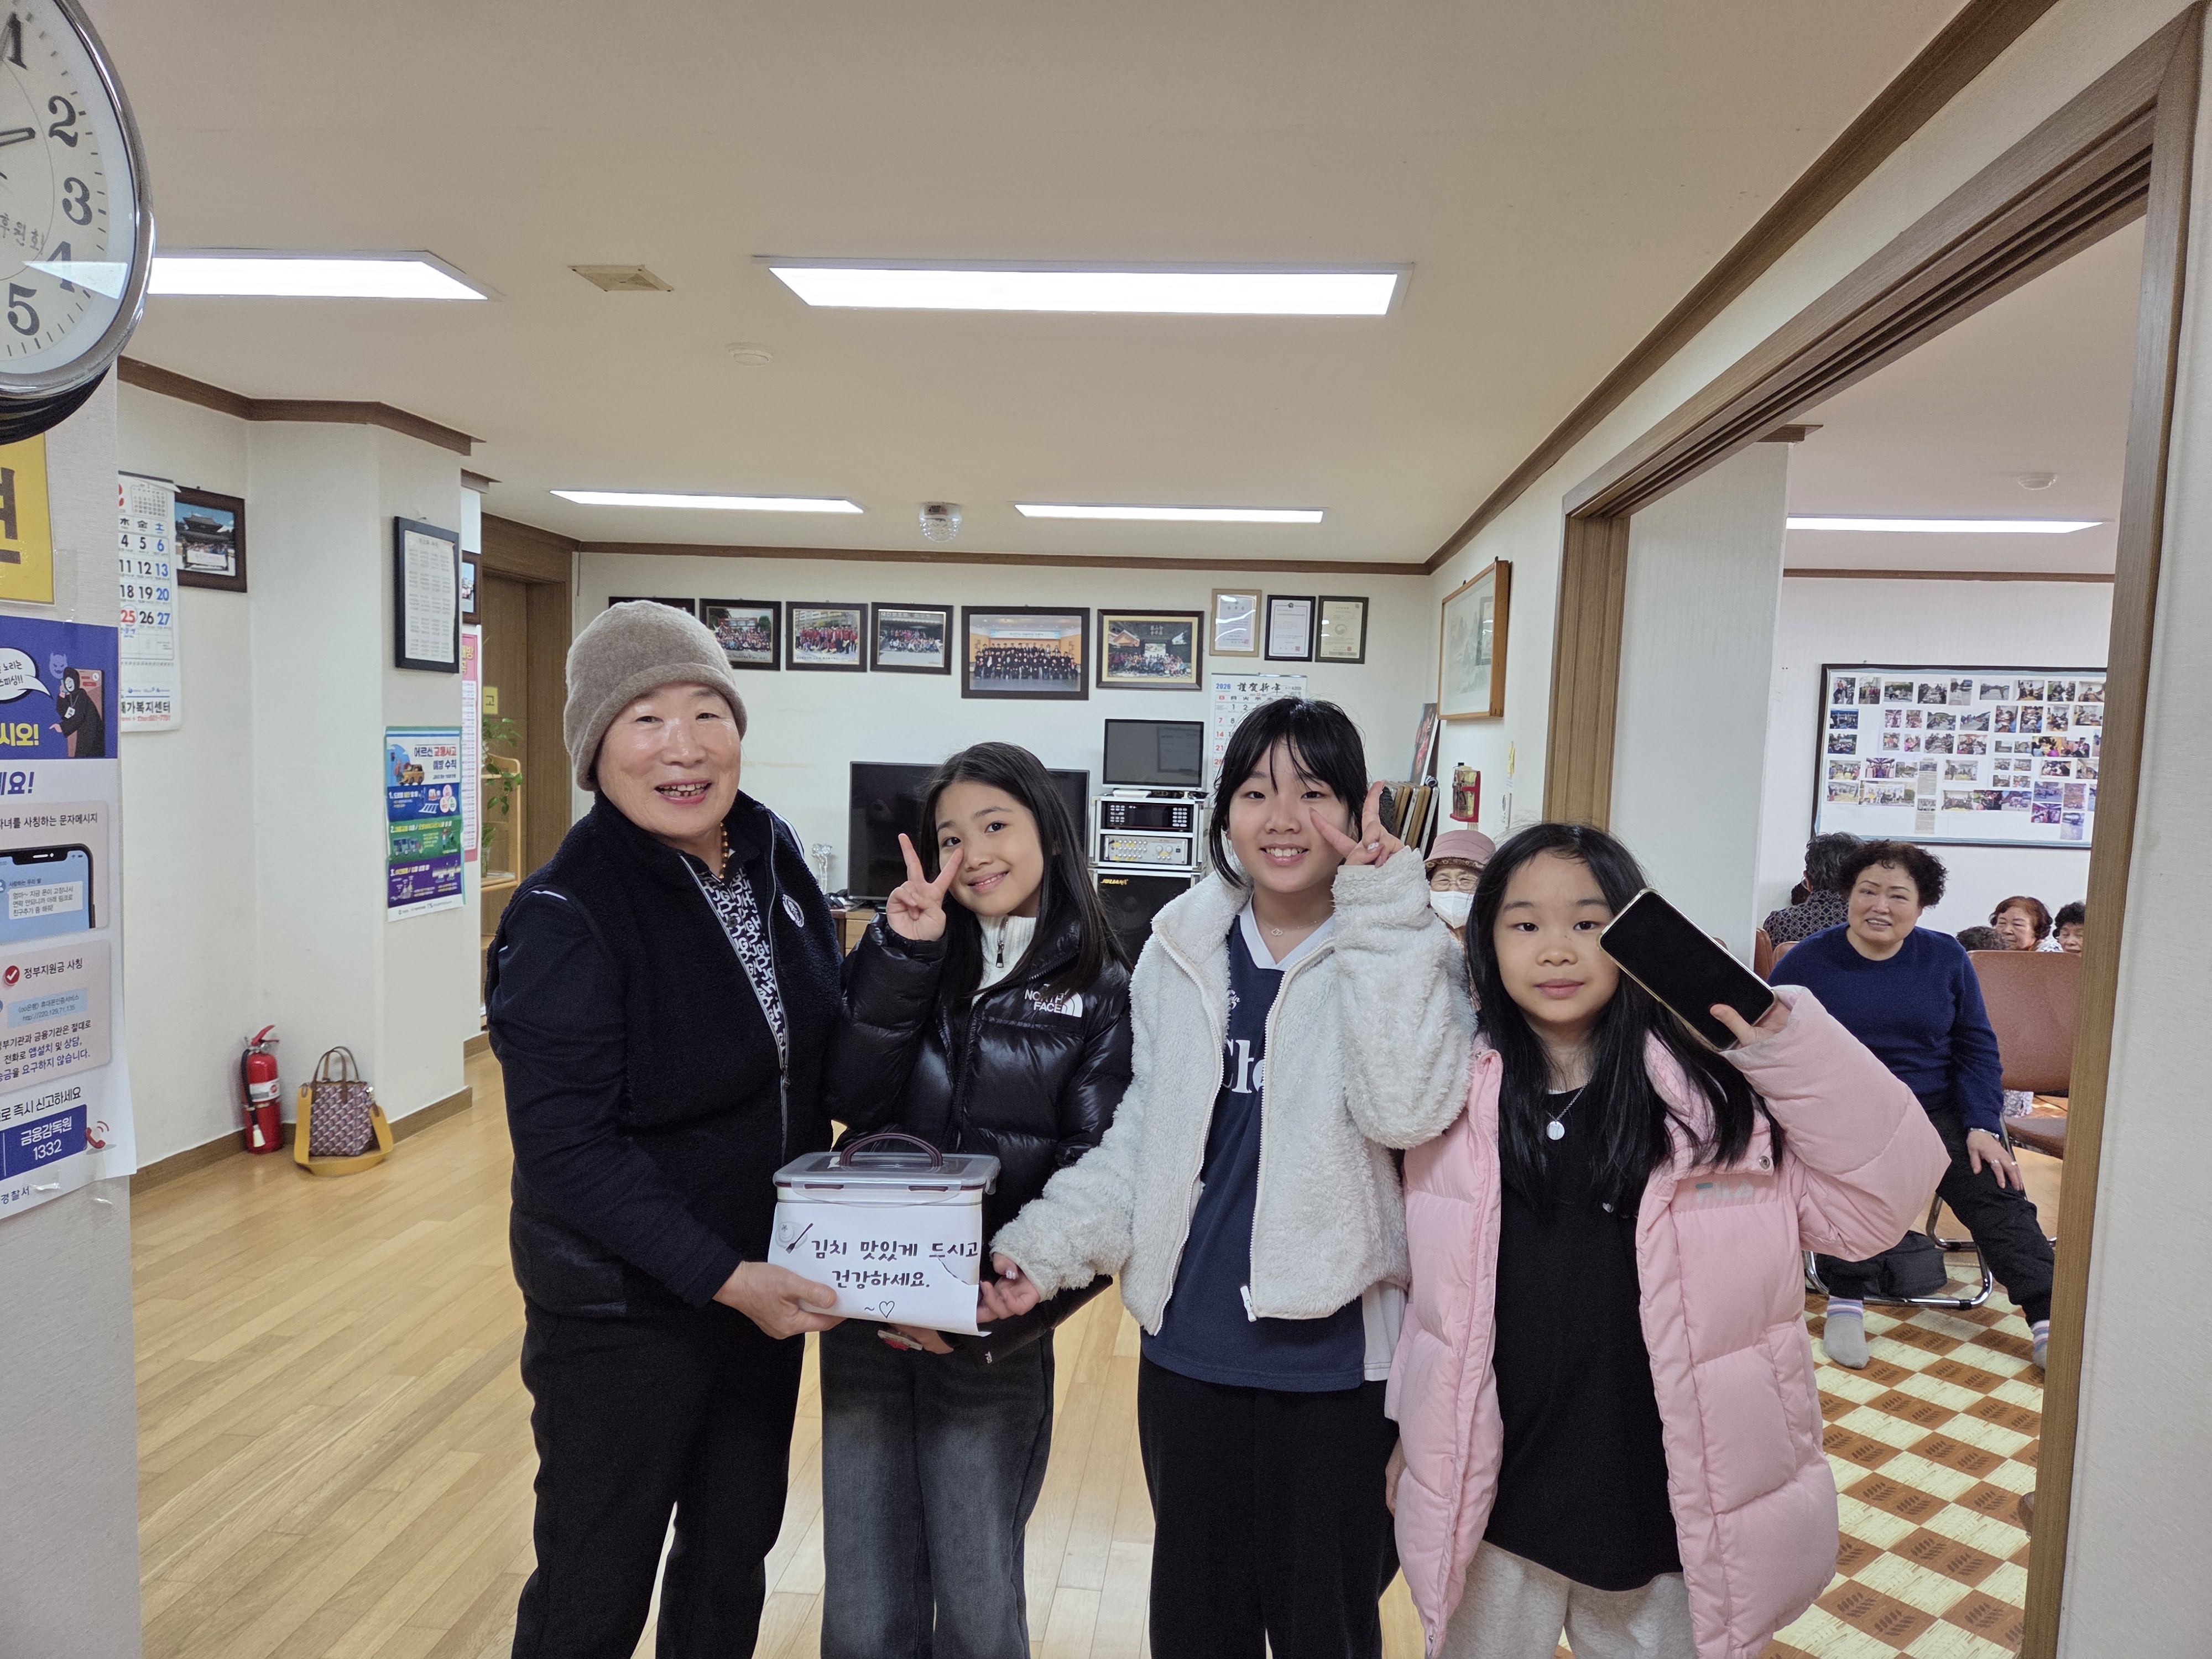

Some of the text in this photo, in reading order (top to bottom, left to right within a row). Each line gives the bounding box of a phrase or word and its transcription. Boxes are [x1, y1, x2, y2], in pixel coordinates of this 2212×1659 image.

[48, 95, 78, 148] 2
[62, 177, 93, 226] 3
[7, 283, 40, 336] 5
[119, 518, 130, 526] 木
[154, 523, 165, 531] 土
[121, 534, 164, 552] 4 5 6
[119, 559, 168, 577] 11 12 13
[120, 585, 170, 601] 18 19 20
[121, 609, 171, 625] 25 26 27
[3, 660, 23, 671] 노리는
[414, 747, 433, 757] 어르신
[445, 759, 456, 770] 수칙
[24, 816, 56, 828] 사칭하는
[59, 812, 98, 826] 문자메시지
[24, 958, 83, 979] 정부지원금 사칭
[1034, 1001, 1062, 1013] FACE
[34, 1025, 69, 1042] 금융기관은
[71, 1020, 91, 1032] 절대로
[4, 1036, 82, 1065] 전화로 앱설치 및 상담,
[22, 1057, 54, 1074] 요구하지
[57, 1048, 90, 1066] 않습니다.
[14, 1100, 33, 1117] 즉시
[36, 1087, 81, 1112] 신고하세요
[20, 1116, 72, 1146] 금융감독원
[33, 1139, 62, 1160] 1332
[1695, 1179, 1755, 1203] FILA
[811, 1239, 978, 1262] 김치 맛있게 드시고
[832, 1270, 930, 1290] 건강하세요.
